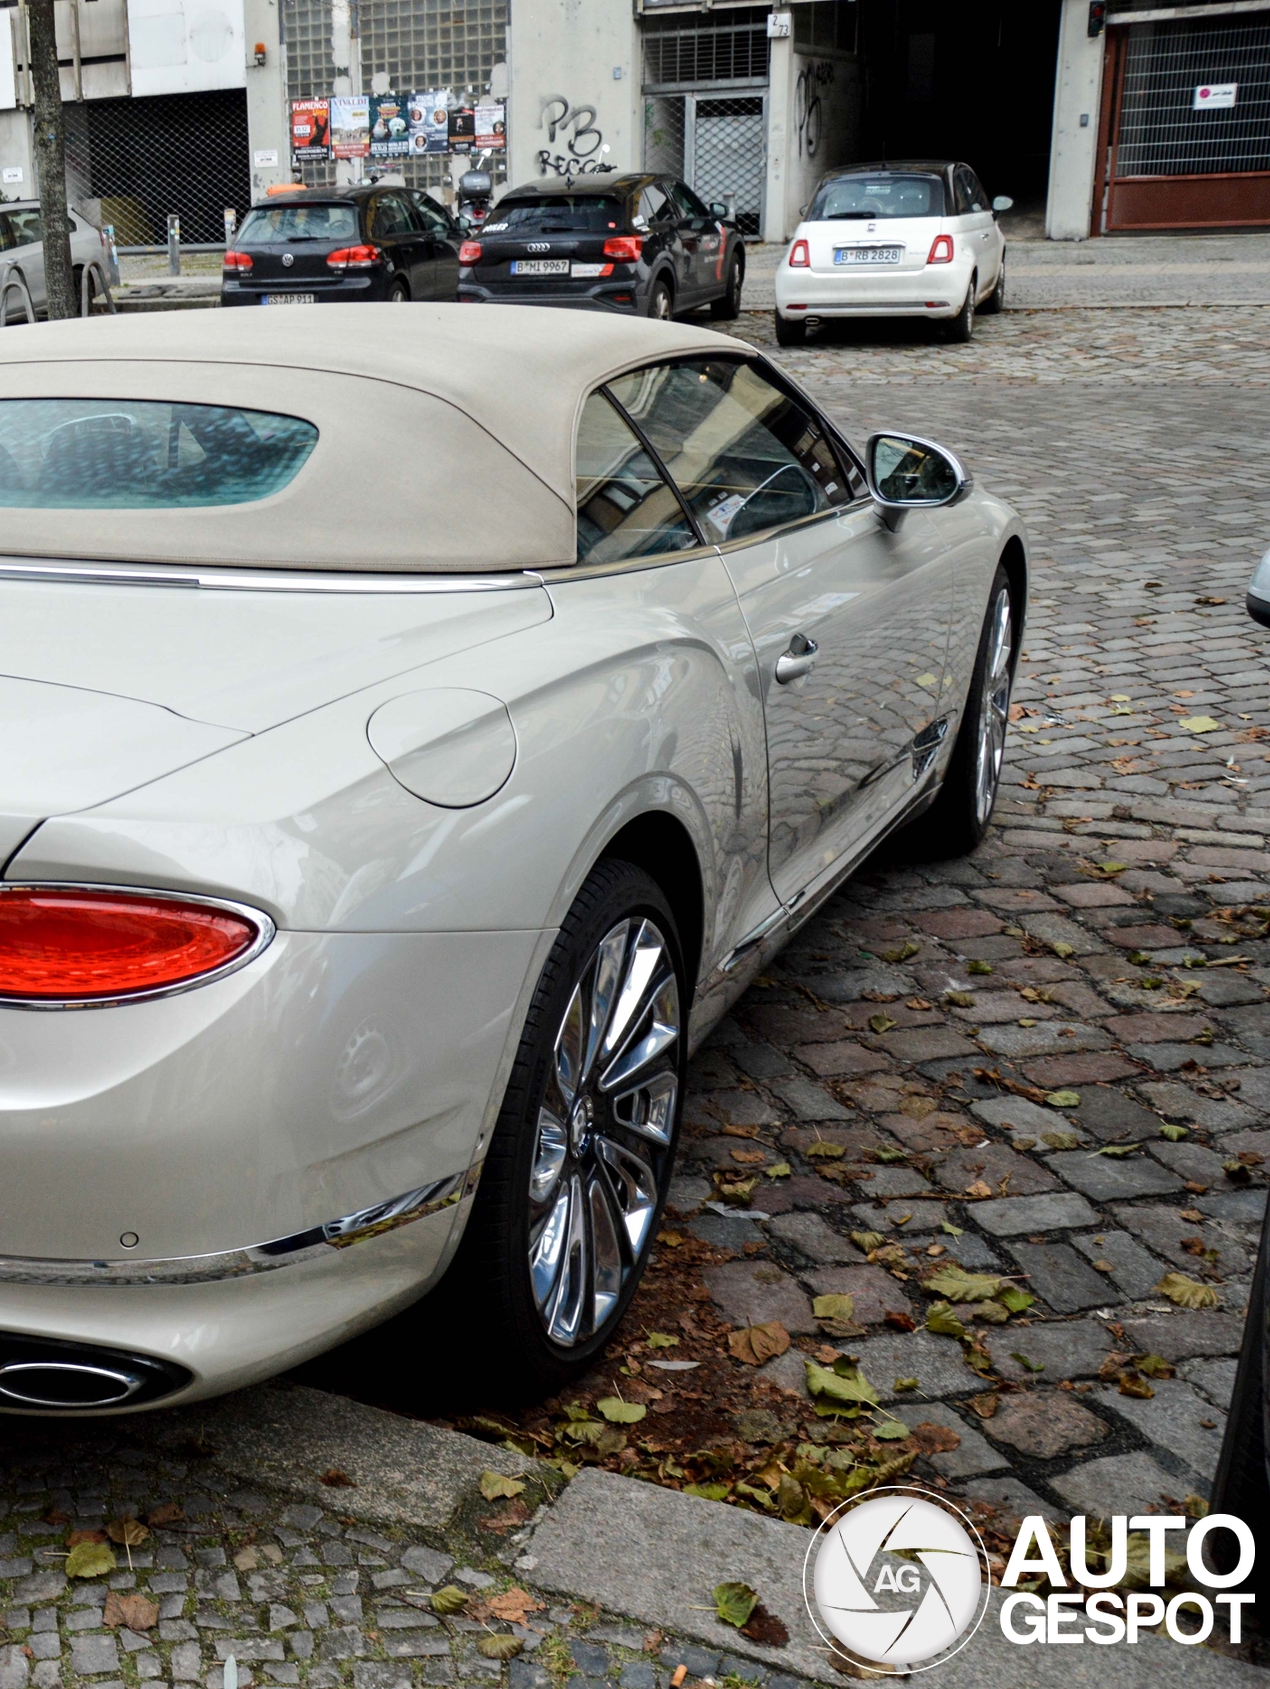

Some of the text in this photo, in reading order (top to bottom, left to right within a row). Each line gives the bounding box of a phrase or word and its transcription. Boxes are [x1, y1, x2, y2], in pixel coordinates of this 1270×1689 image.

[773, 15, 778, 26] 2
[779, 25, 789, 36] 73
[292, 101, 328, 111] FLAMENCO
[333, 98, 367, 106] VIVALDI
[841, 252, 848, 260] B
[855, 251, 869, 260] RB
[871, 250, 898, 260] 2828
[517, 261, 567, 272] B MI 9967
[267, 294, 313, 304] GS AP 911
